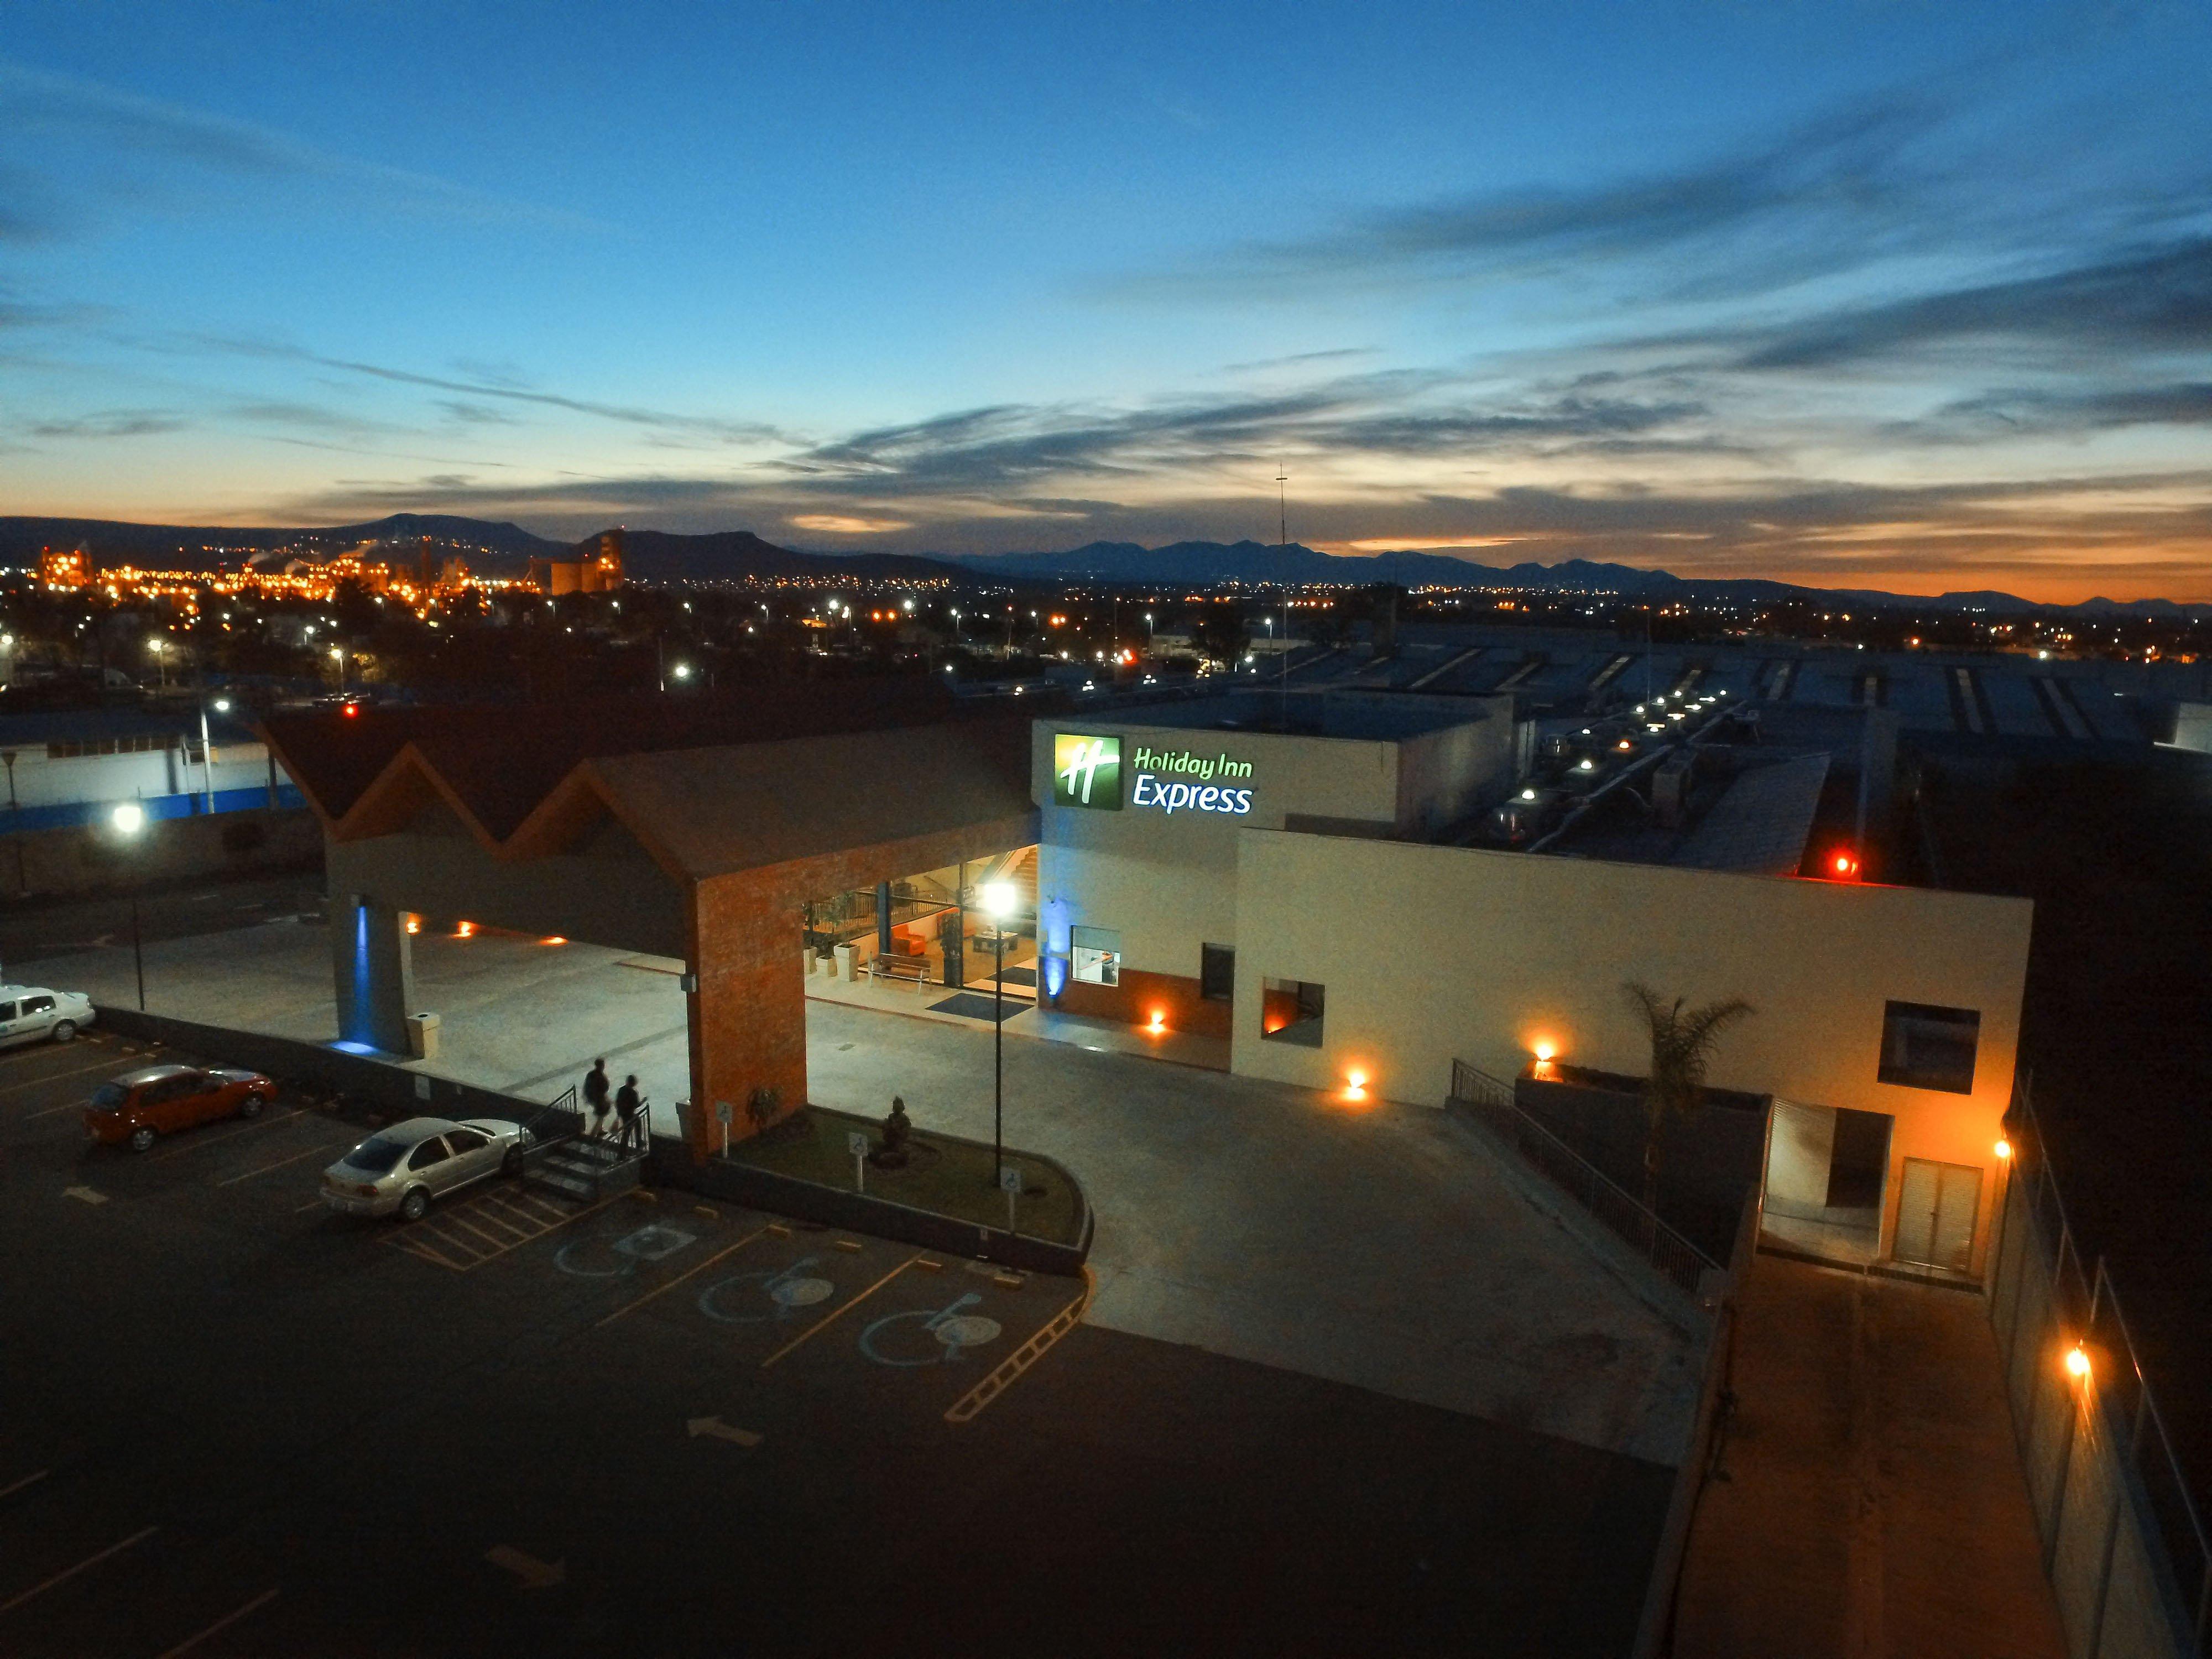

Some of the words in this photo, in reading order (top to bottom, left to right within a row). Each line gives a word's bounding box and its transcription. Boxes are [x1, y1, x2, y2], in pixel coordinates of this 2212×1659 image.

[1134, 747, 1215, 780] Holiday
[1218, 753, 1253, 778] Inn
[1133, 774, 1253, 815] Express
